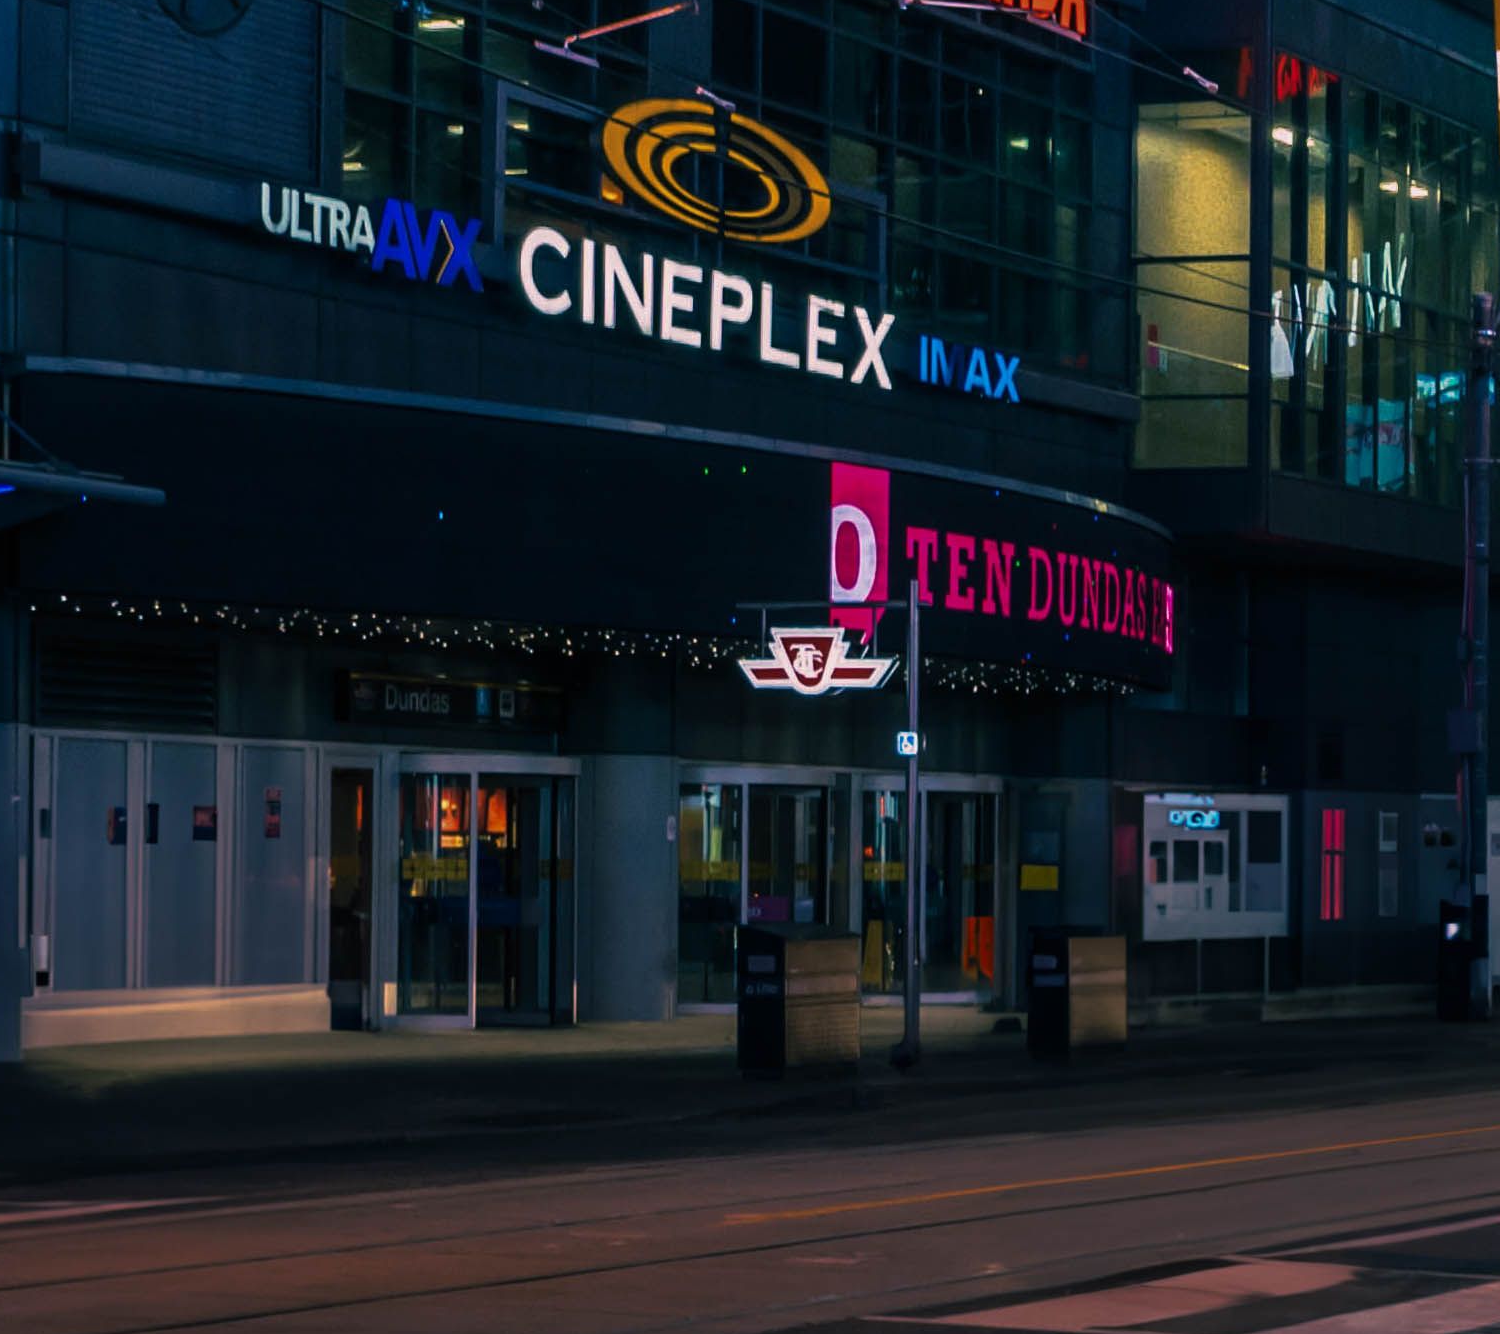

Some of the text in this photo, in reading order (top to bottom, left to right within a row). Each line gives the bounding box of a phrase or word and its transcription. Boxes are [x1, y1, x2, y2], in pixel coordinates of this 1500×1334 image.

[517, 224, 896, 391] CINEPLEX
[905, 525, 1016, 618] TEN
[1027, 545, 1150, 641] DUNDAS
[384, 682, 451, 715] Dundas
